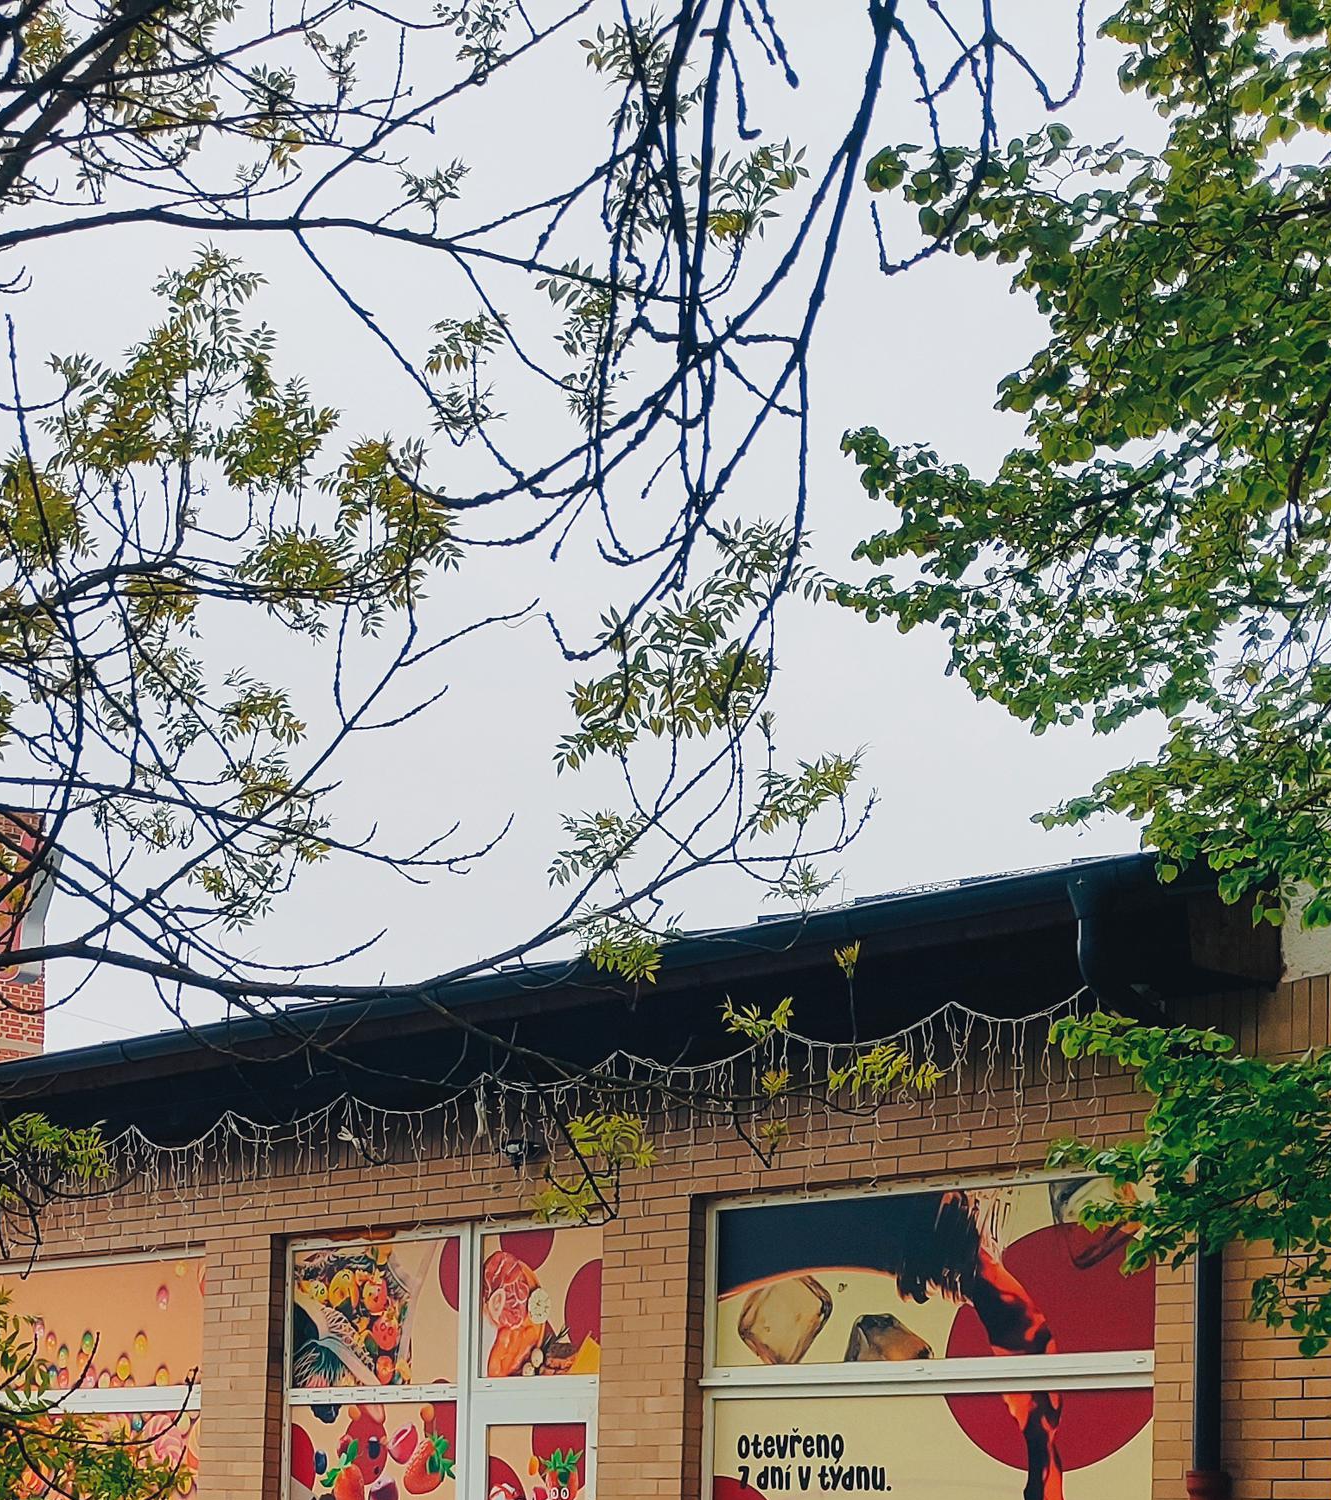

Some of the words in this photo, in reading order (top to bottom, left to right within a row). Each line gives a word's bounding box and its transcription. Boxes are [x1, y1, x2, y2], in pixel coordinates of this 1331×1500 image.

[737, 1428, 845, 1460] otevřeno
[737, 1465, 750, 1490] 7
[756, 1464, 792, 1491] dní
[797, 1465, 812, 1491] v
[817, 1459, 893, 1492] týdnu.
